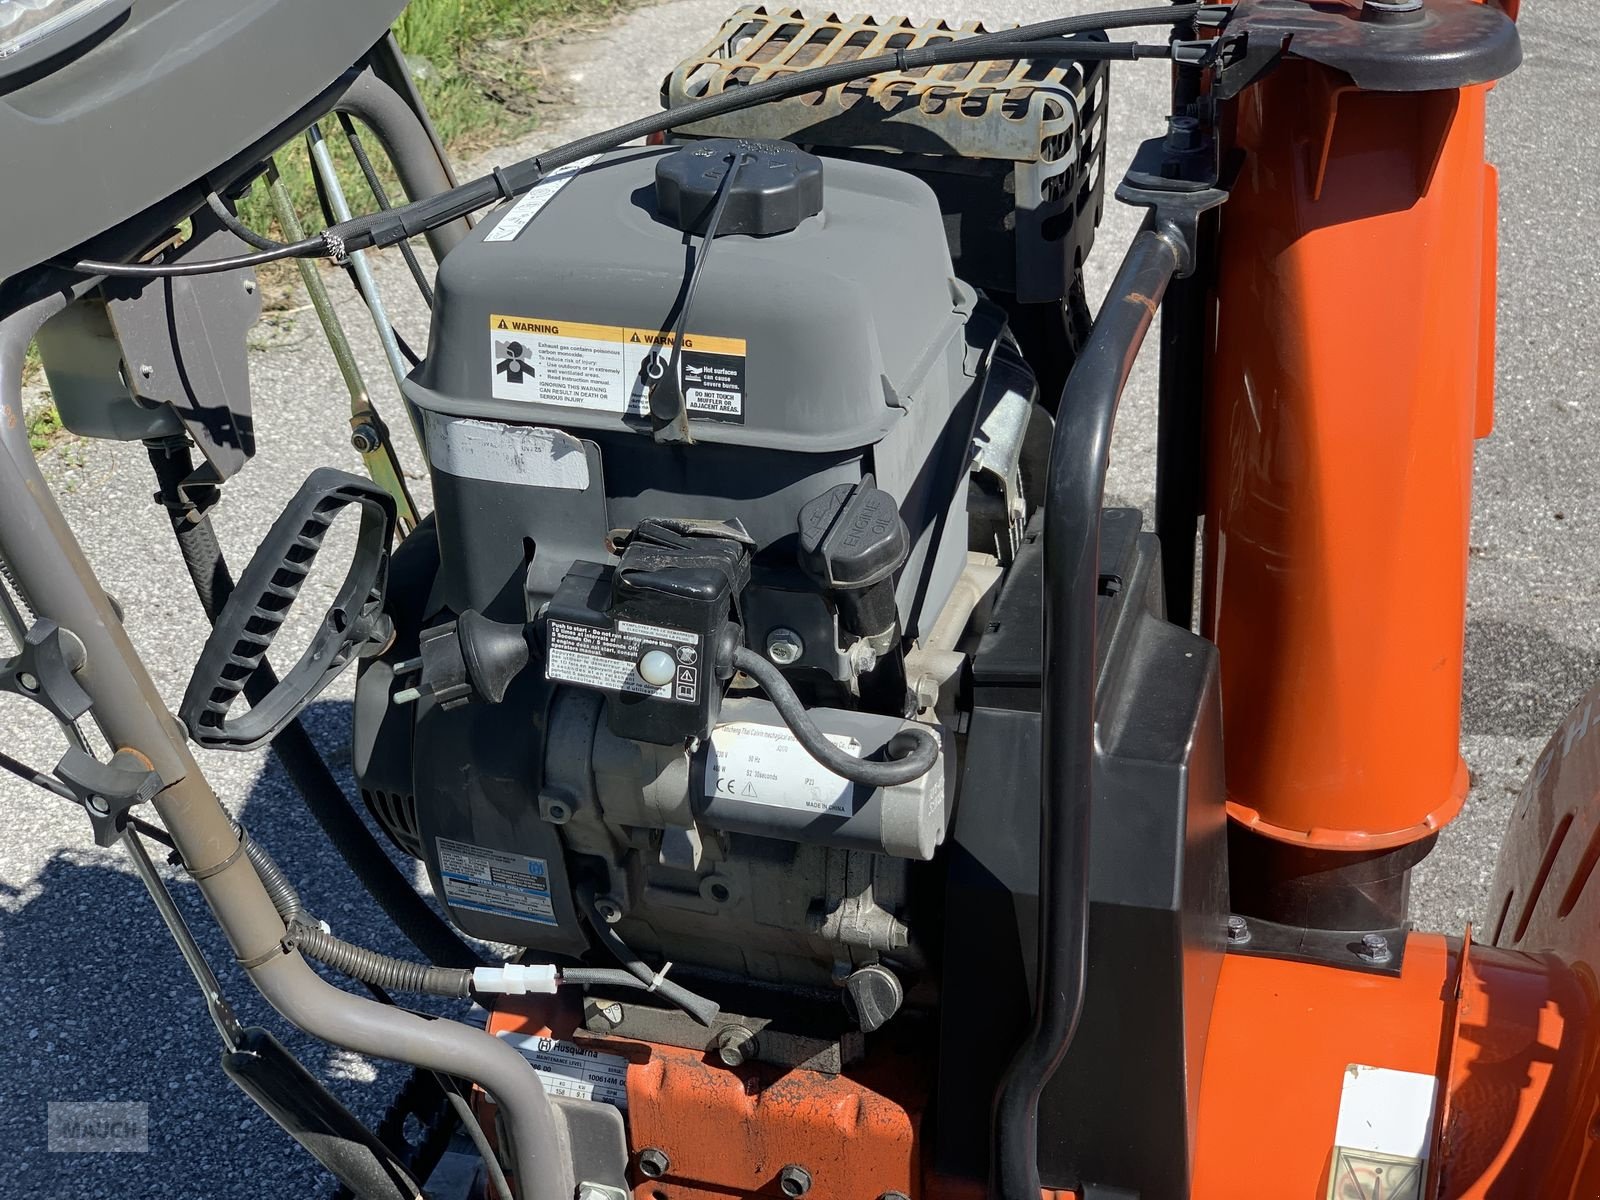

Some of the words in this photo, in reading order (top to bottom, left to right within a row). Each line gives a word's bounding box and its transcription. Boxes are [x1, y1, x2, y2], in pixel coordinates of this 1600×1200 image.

[512, 321, 559, 334] WARNING
[644, 335, 692, 348] WARNG
[539, 381, 566, 389] IGNORING
[581, 385, 606, 393] WARNING
[690, 402, 718, 410] ADJACENT
[697, 397, 722, 405] MUFFLER
[843, 499, 880, 547] ENGINE
[872, 516, 892, 534] OIL
[557, 632, 581, 641] Seconds
[603, 641, 626, 650] seconds
[585, 632, 608, 641] intervals
[551, 643, 578, 651] operators
[579, 647, 602, 655] manual.
[557, 638, 574, 646] engine
[601, 645, 616, 654] start,
[506, 884, 524, 892] ONLY
[554, 1043, 598, 1058] Husqvarna
[536, 1055, 568, 1066] MAINTENANCE
